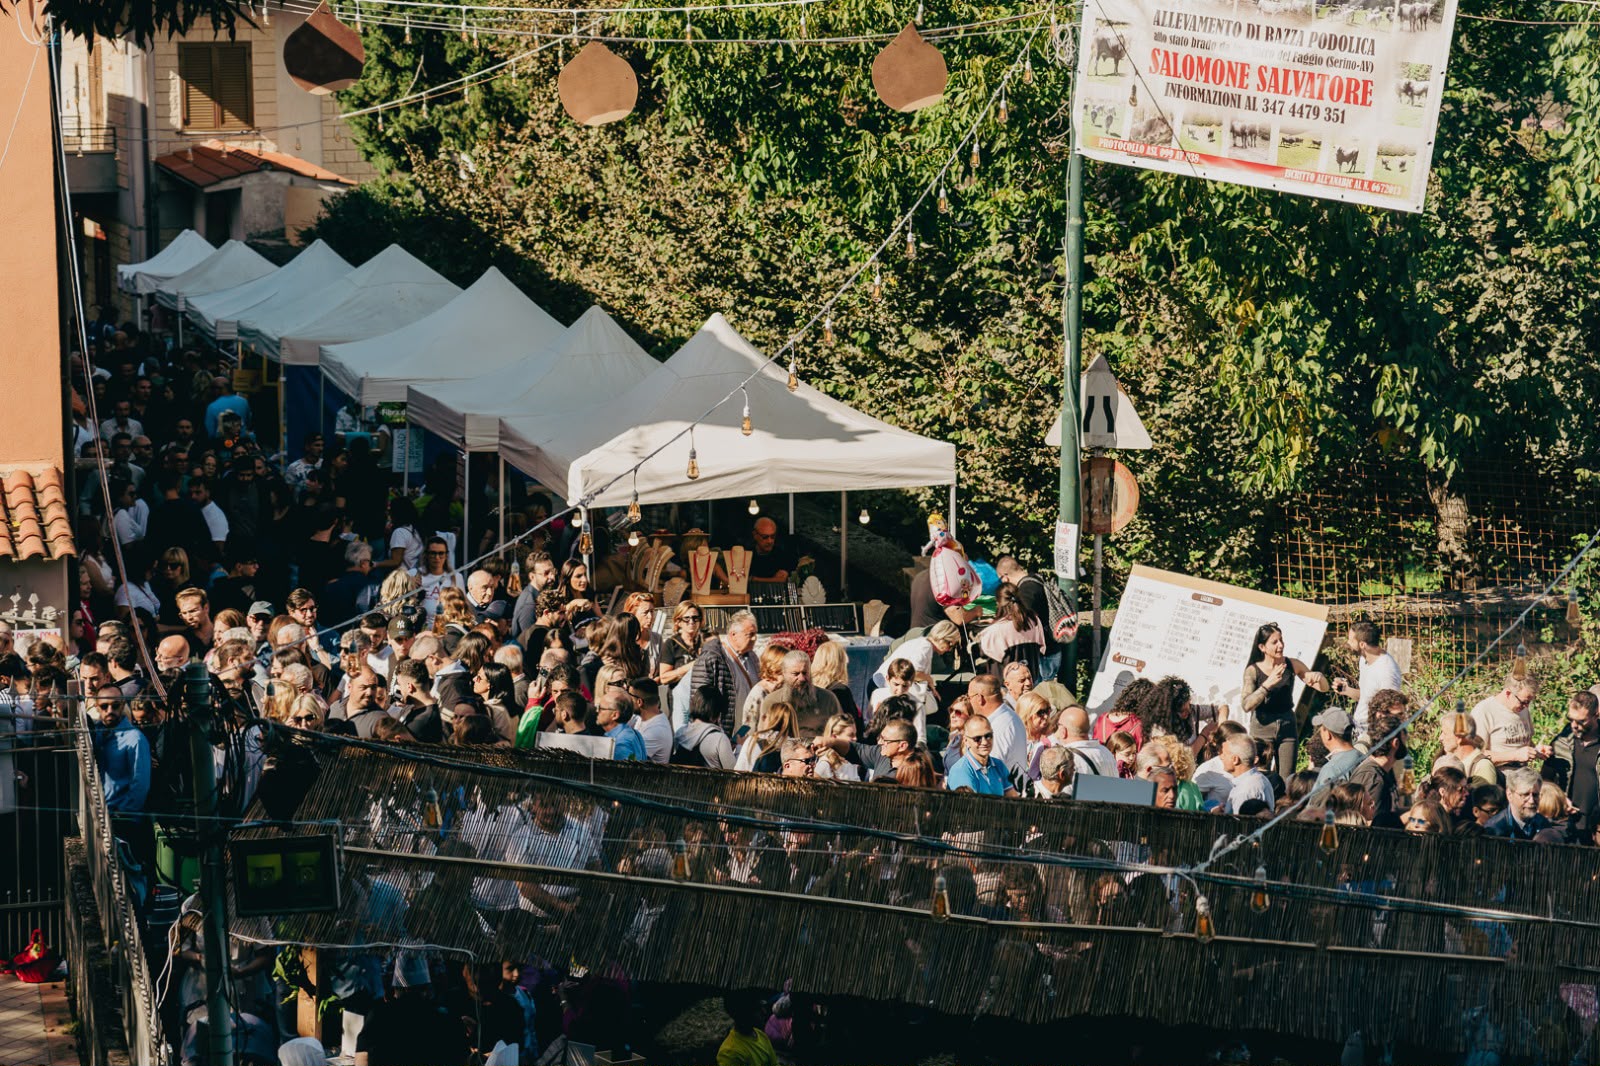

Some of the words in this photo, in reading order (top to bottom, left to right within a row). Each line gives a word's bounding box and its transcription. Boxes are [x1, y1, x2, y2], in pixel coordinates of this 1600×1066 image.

[1153, 9, 1242, 38] ALLEVAMENTO
[1246, 23, 1261, 41] DI
[1264, 25, 1305, 48] RAZZA
[1308, 31, 1375, 56] PODOLICA
[1153, 31, 1167, 43] allo
[1169, 33, 1189, 47] stato
[1191, 36, 1217, 51] brado
[1292, 52, 1324, 67] Faggio
[1326, 55, 1374, 74] (Serino-AV)
[1149, 47, 1251, 90] SALOMONE
[1256, 65, 1374, 107] SALVATORE
[1164, 82, 1242, 109] INFORMAZIONI
[1244, 95, 1258, 112] AL
[1262, 98, 1285, 116] 347
[1289, 102, 1320, 121] 4479
[1323, 106, 1346, 124] 351
[1099, 138, 1145, 154] PROTOCOLLO
